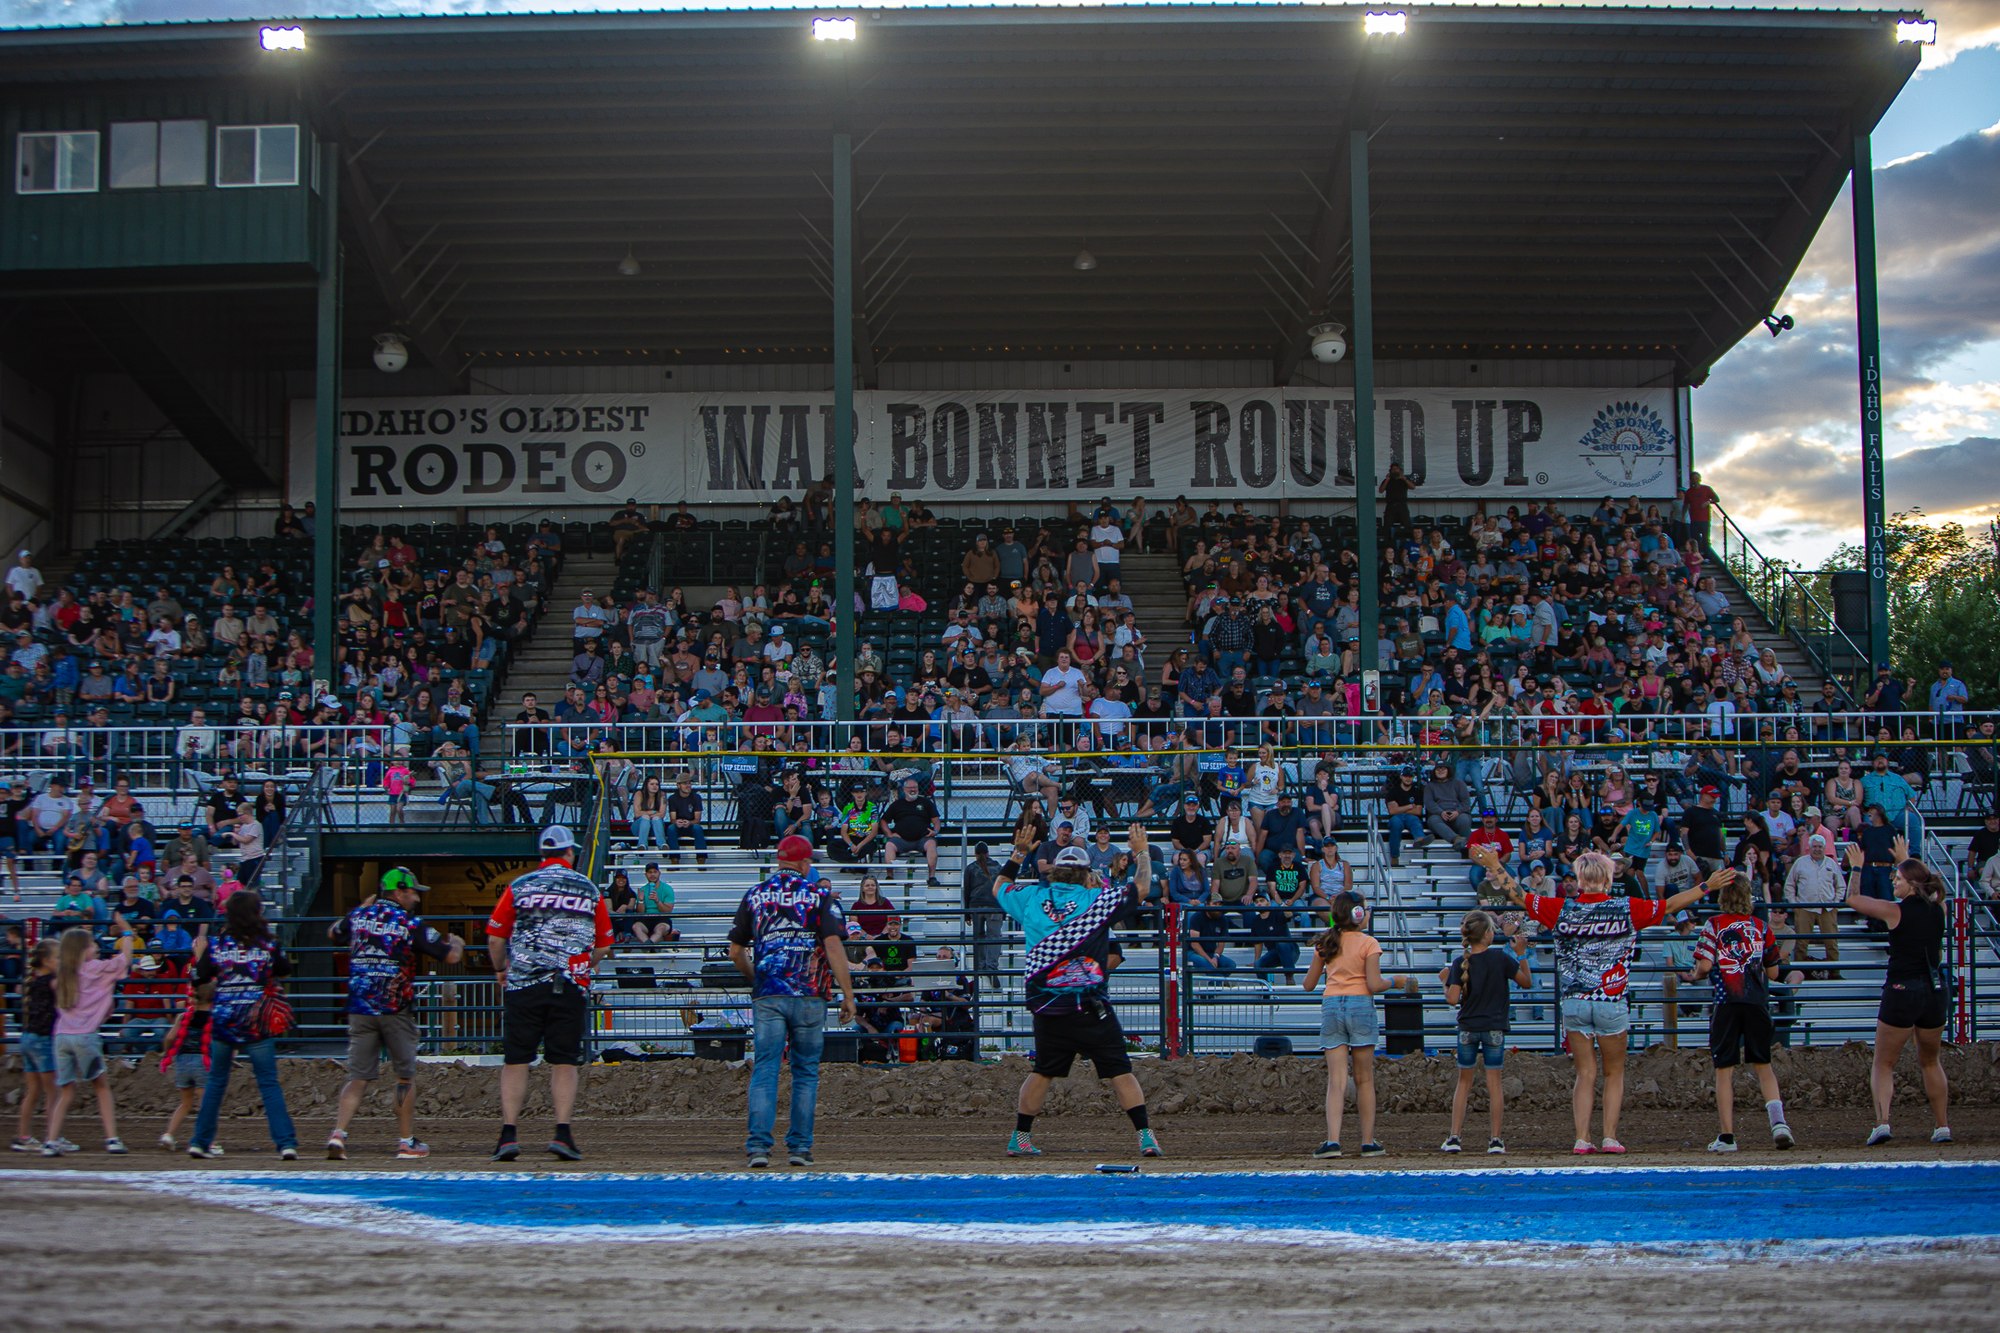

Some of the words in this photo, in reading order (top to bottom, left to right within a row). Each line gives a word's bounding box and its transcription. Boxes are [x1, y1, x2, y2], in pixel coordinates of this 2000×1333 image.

[1866, 355, 1880, 421] IDAHO
[499, 405, 650, 434] OLDEST
[1578, 422, 1613, 446] WAR
[1614, 418, 1677, 446] BONNET
[885, 401, 1165, 491] BONNET
[1450, 399, 1543, 488] UP
[350, 440, 627, 496] RODEO
[1868, 433, 1882, 500] FALLS
[1871, 512, 1885, 579] IDAHO
[723, 763, 735, 771] VIP
[735, 763, 757, 773] SEATING
[1200, 762, 1210, 770] VIP
[1275, 869, 1299, 880] STOP
[1557, 921, 1629, 937] OFFICIAL
